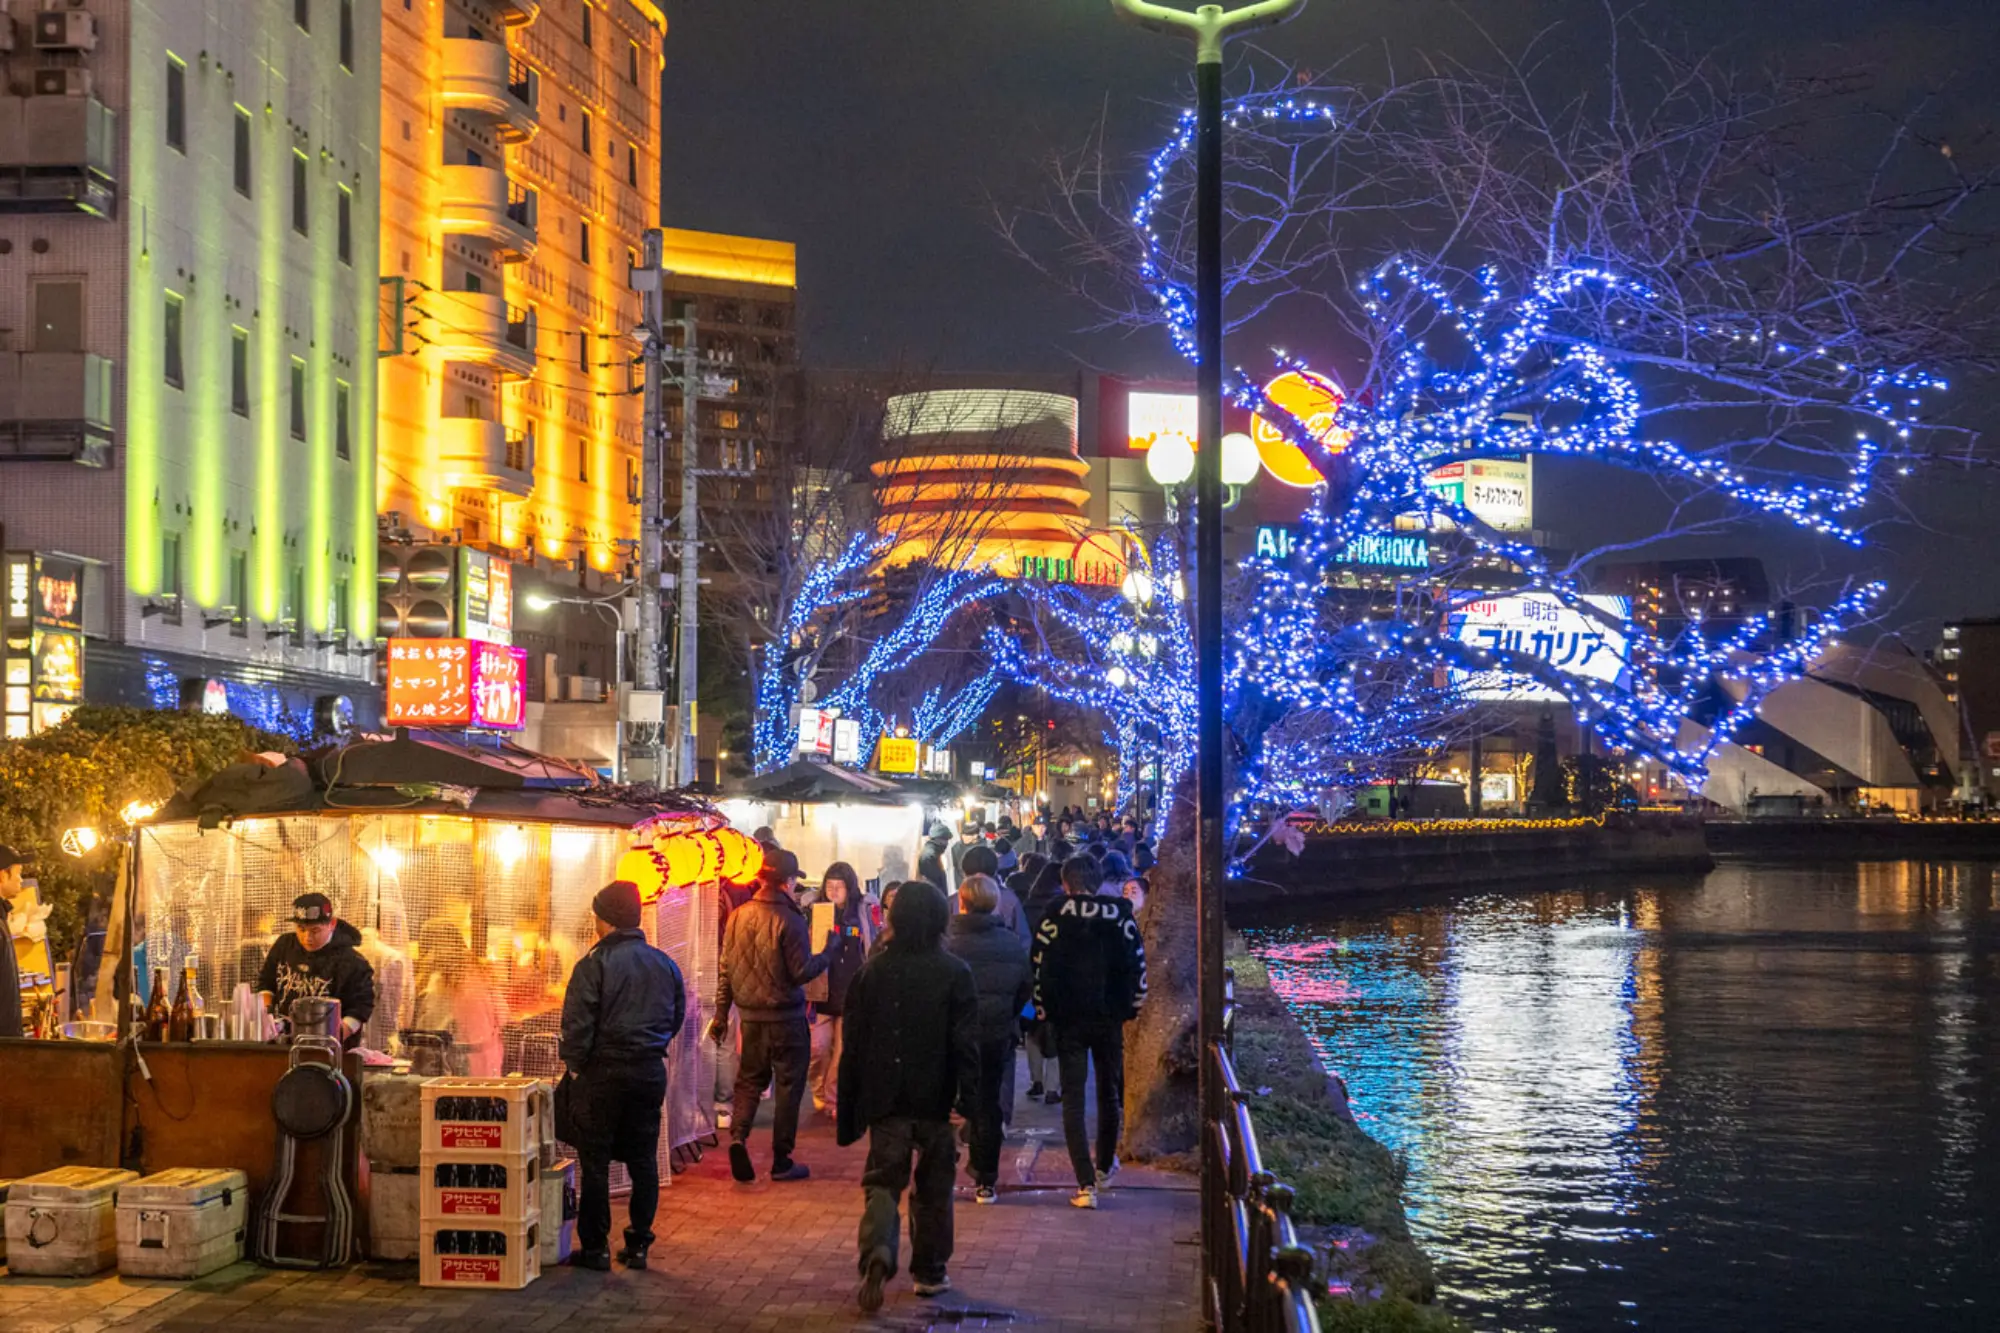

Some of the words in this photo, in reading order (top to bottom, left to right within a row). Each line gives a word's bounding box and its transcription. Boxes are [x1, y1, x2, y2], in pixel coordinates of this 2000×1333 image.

[1523, 602, 1559, 622] 明治
[391, 647, 406, 716] 焼とり
[406, 647, 421, 716] おでん
[423, 647, 437, 717] もつ焼
[438, 646, 453, 715] 焼ラーメン
[453, 646, 468, 716] ラーメン
[443, 1127, 500, 1138] アサヒビール
[443, 1193, 499, 1204] アサヒビール
[443, 1259, 498, 1271] アサヒビール
